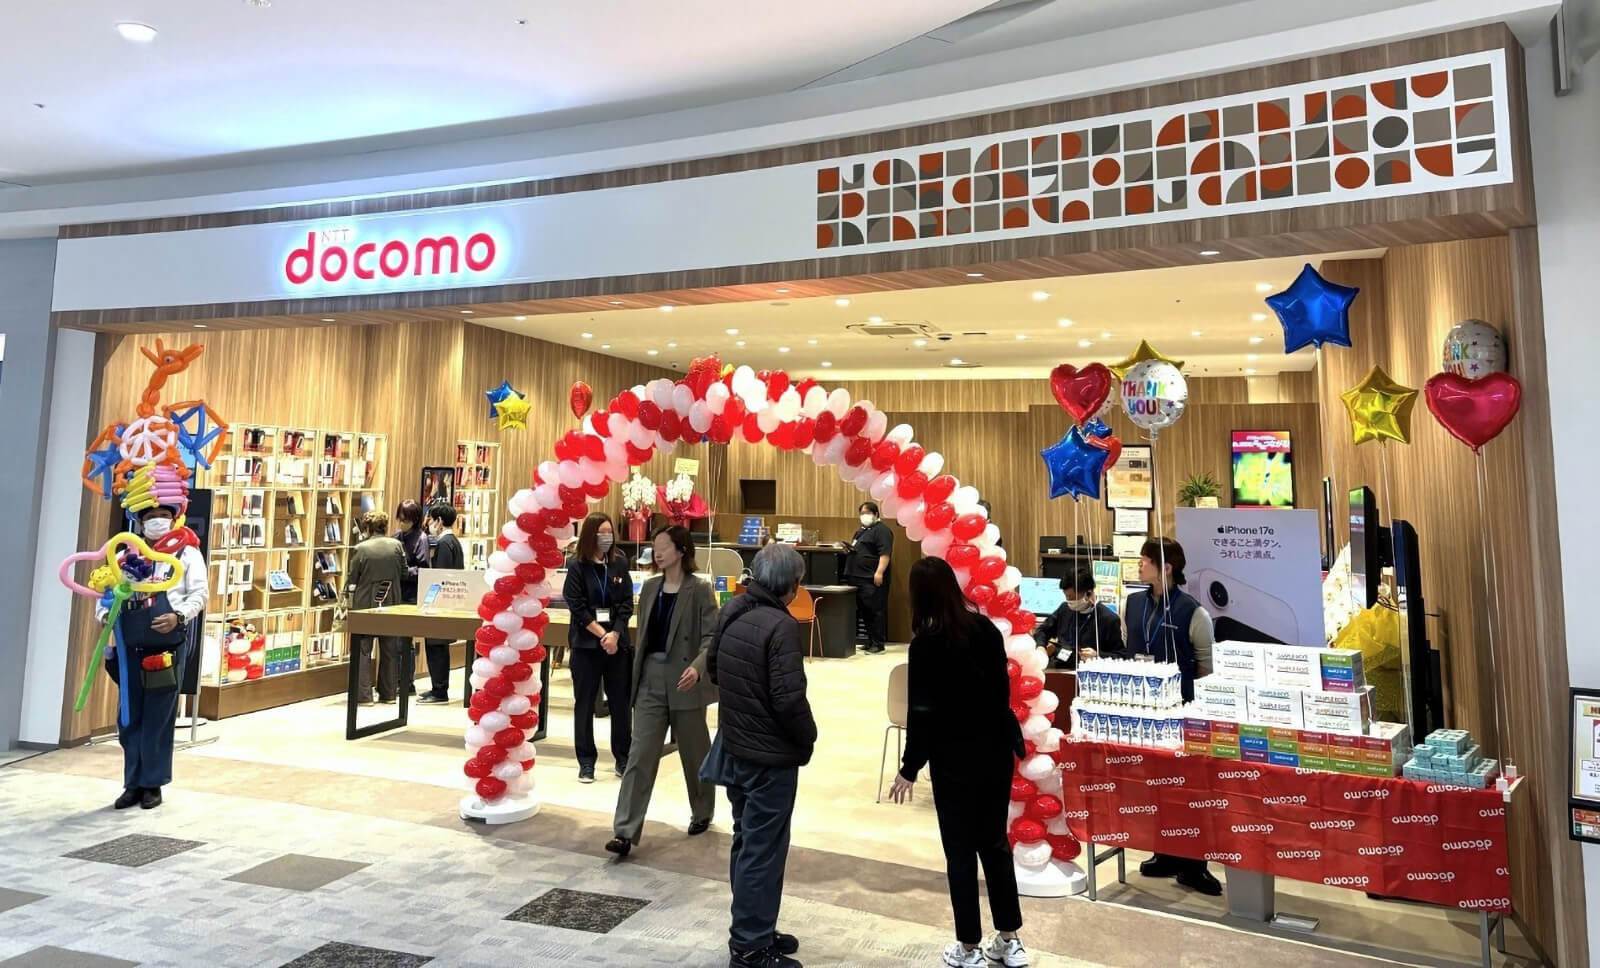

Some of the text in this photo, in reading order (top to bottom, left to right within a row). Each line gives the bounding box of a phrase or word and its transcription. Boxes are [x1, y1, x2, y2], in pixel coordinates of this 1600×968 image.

[321, 228, 350, 243] NTT
[285, 231, 496, 285] docomo
[1123, 380, 1167, 397] THANK
[1225, 525, 1274, 535] iPhone 17e
[1105, 754, 1144, 765] docomo
[1217, 769, 1261, 781] docomo
[1145, 776, 1186, 787] docomo
[1079, 783, 1117, 793] docomo
[1343, 788, 1390, 800] docomo
[1188, 798, 1229, 810] docomo
[1262, 795, 1307, 805] docomo
[1063, 810, 1089, 820] doco
[1118, 804, 1158, 815] docomo
[1478, 807, 1505, 817] omo
[1309, 819, 1356, 831] docomo
[1391, 814, 1439, 826] docomo
[1160, 827, 1201, 838] docomo
[1230, 823, 1274, 835] docomo
[1091, 831, 1130, 842] docomo
[1357, 845, 1405, 857] docomo
[1441, 839, 1493, 851] docomo
[1203, 852, 1243, 863] docomo
[1276, 850, 1321, 861] docomo
[1323, 875, 1370, 887] docomo
[1406, 871, 1456, 883] docomo
[1458, 897, 1510, 909] docomo
